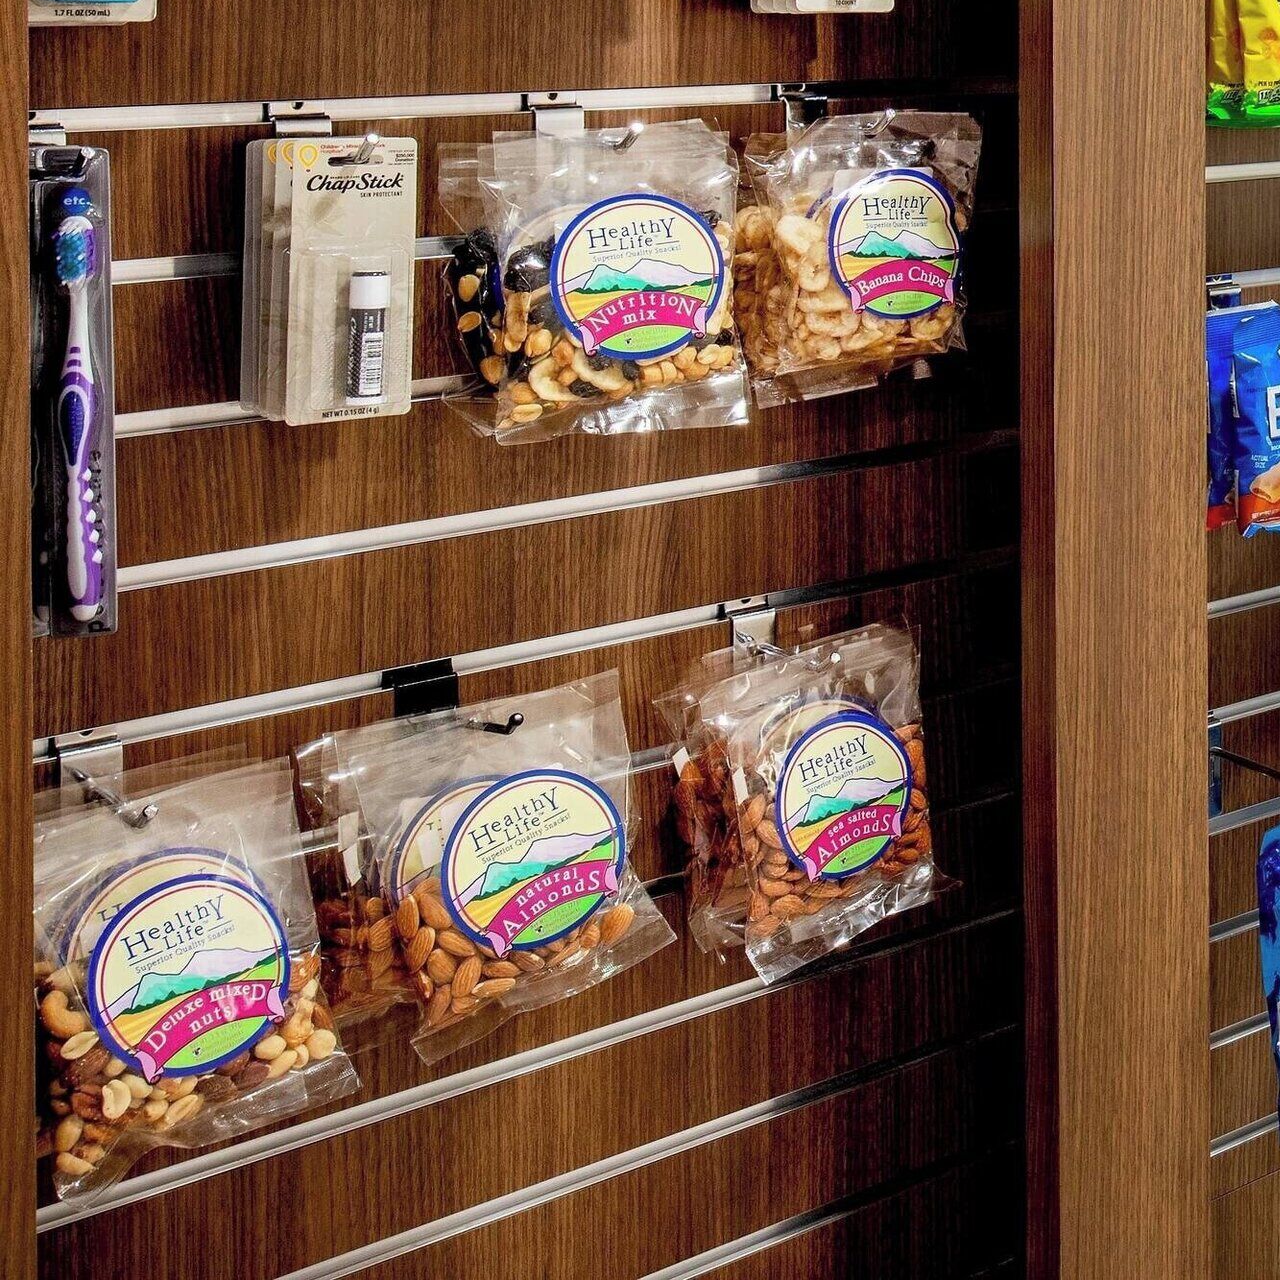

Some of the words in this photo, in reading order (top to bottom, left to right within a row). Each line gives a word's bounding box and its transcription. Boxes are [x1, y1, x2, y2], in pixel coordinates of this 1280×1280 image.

[64, 197, 90, 205] etc.
[619, 237, 653, 251] Life
[856, 272, 903, 295] Banana
[908, 267, 946, 287] Chips
[622, 310, 656, 325] mix
[505, 817, 541, 841] Life
[828, 823, 844, 837] sea
[848, 810, 877, 824] salted
[515, 868, 578, 907] natural
[135, 953, 174, 974] Superior
[175, 939, 205, 956] Quality
[208, 925, 235, 941] Snacks!
[163, 925, 204, 949] Life
[145, 997, 204, 1053] Deluxe
[189, 1006, 233, 1033] nuts
